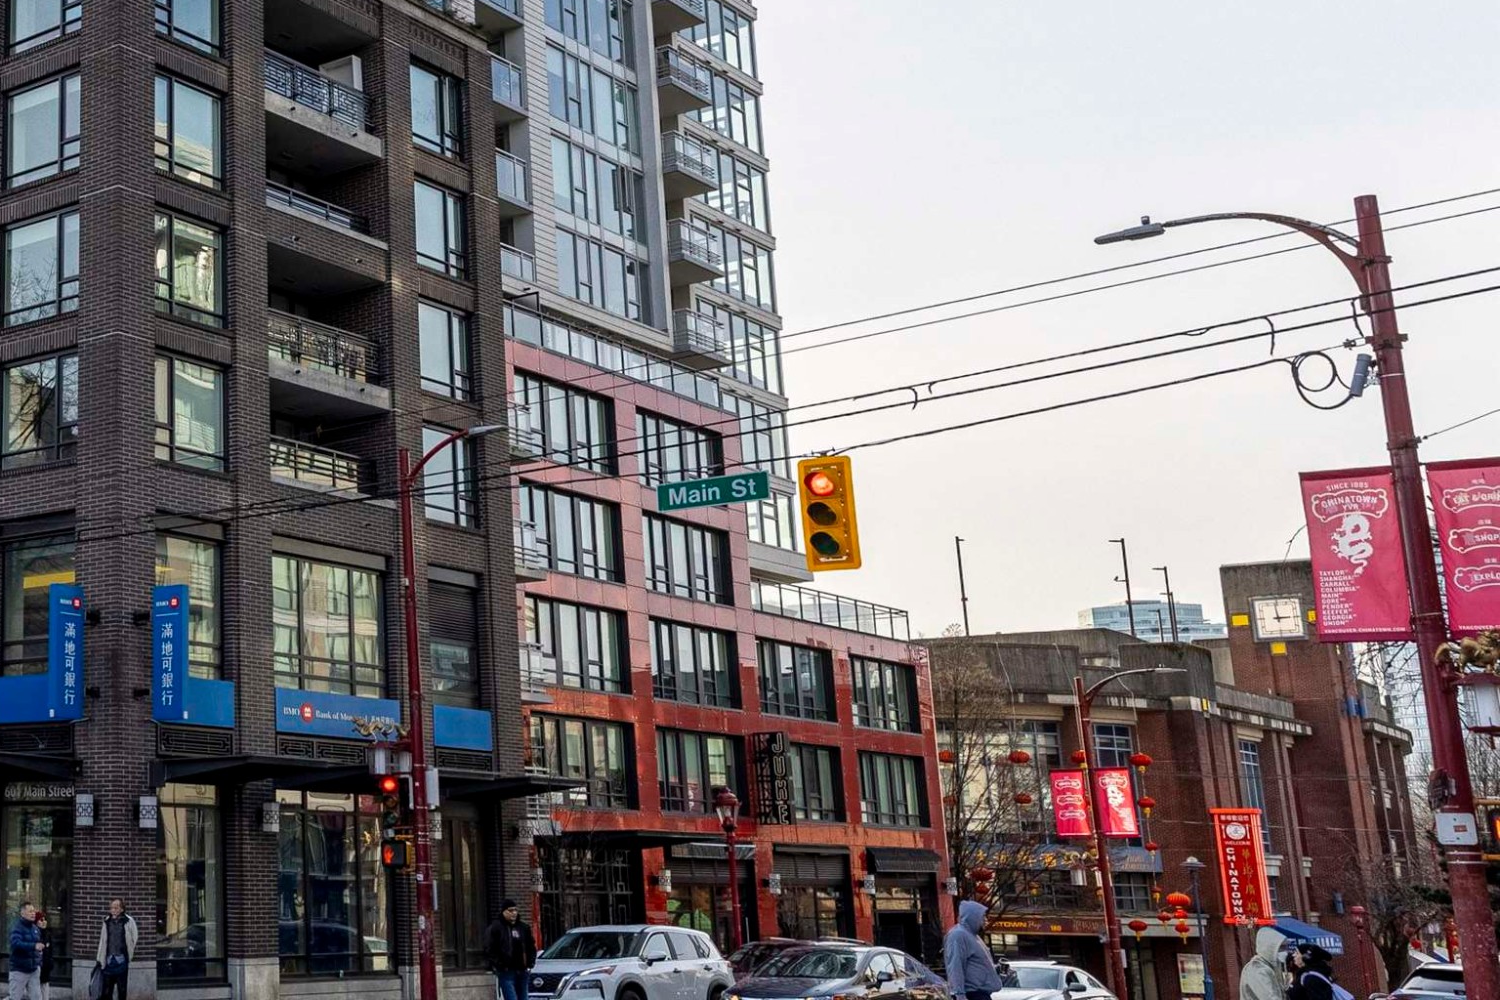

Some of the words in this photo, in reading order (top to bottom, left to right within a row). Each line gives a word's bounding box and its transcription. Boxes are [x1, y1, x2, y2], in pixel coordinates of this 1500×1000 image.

[668, 484, 721, 506] Main
[731, 478, 757, 498] St
[1321, 494, 1378, 509] CHINATOWN
[1326, 483, 1349, 492] SINCE
[64, 622, 76, 705] 滿地可銀行
[161, 622, 173, 706] 滿地可銀行
[283, 707, 301, 717] BMO
[315, 709, 332, 720] Bank
[4, 785, 21, 799] 601
[23, 784, 47, 798] Main
[48, 784, 75, 798] Street
[771, 732, 790, 825] JUKE
[1226, 847, 1244, 914] CHINATOWN
